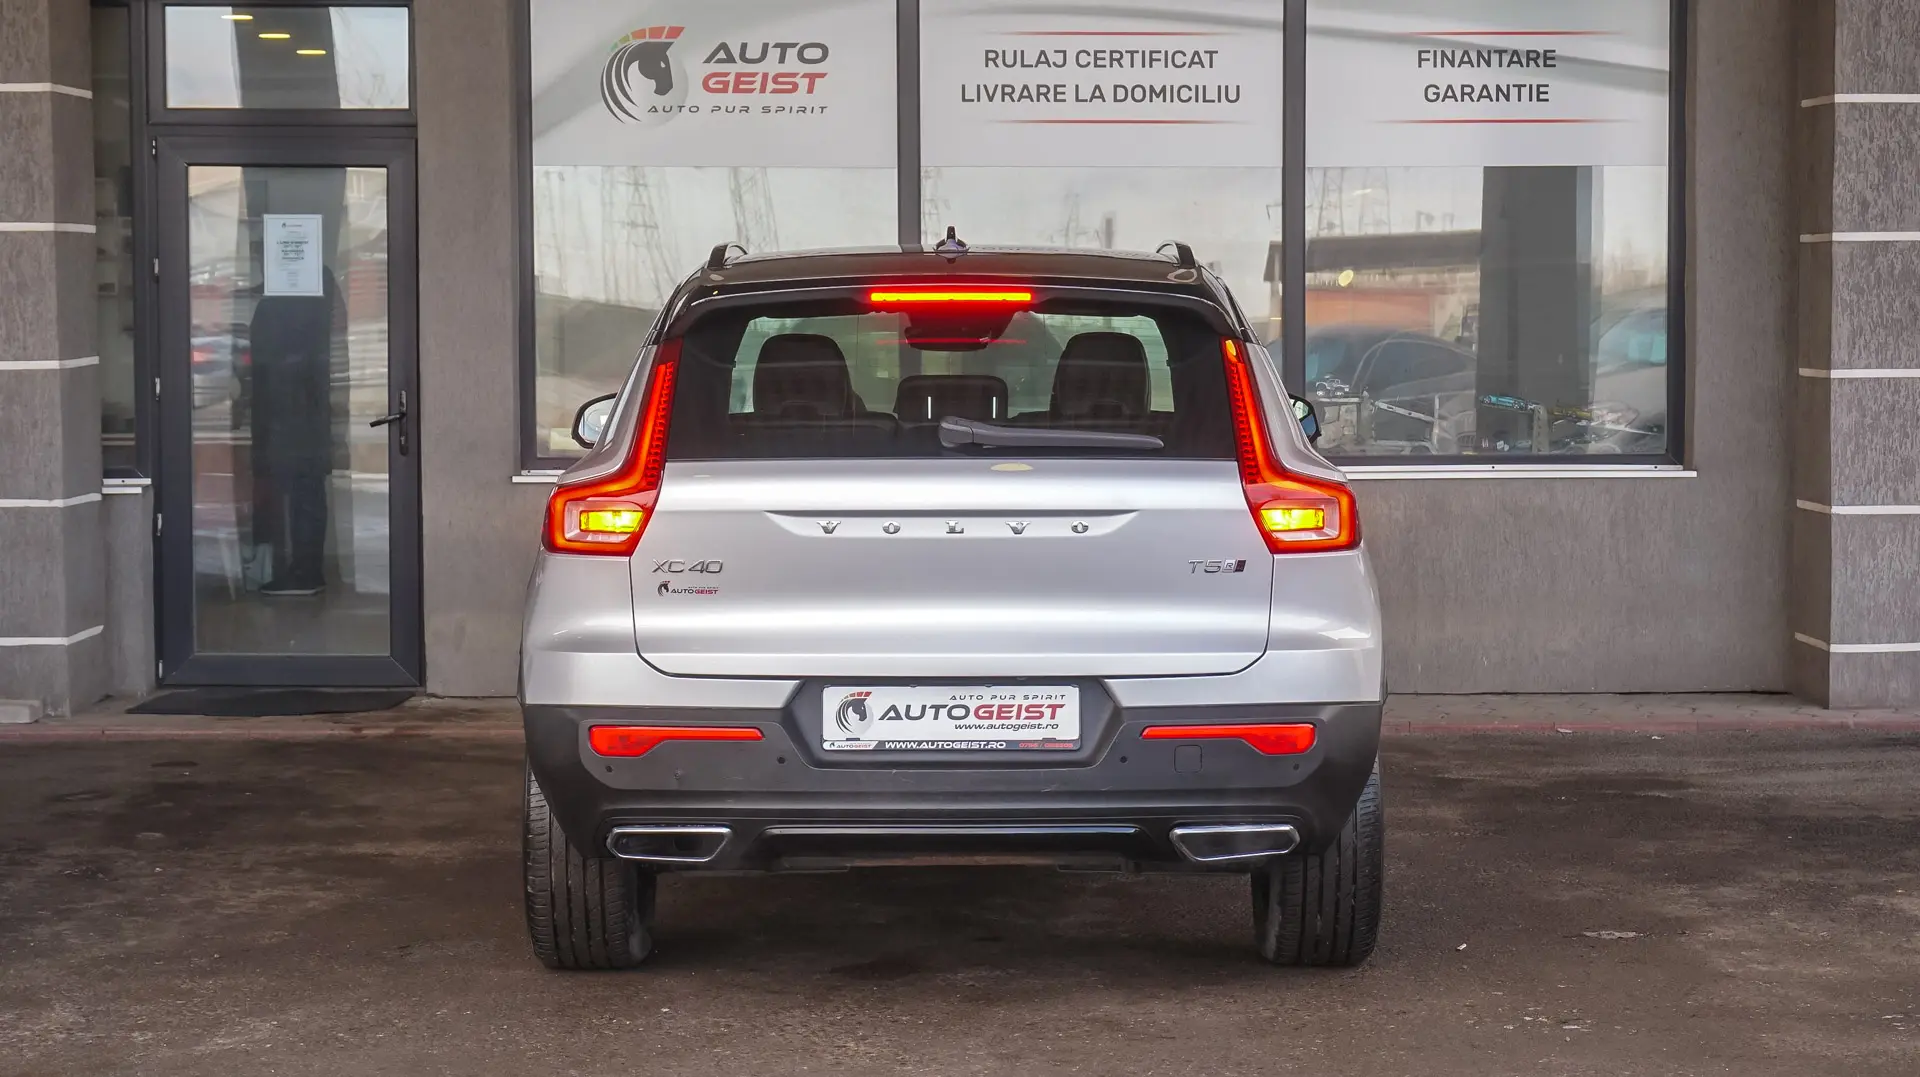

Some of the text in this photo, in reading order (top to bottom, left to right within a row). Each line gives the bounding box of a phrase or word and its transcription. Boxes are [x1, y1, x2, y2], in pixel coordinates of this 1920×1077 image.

[702, 41, 829, 65] AUTO
[984, 49, 1219, 69] RULAJ CERTIFICAT
[1416, 49, 1557, 69] FINANTARE
[702, 72, 828, 94] GEIST
[1423, 83, 1551, 103] GARANTIE
[960, 84, 1242, 104] LIVRARE LA DOMICILIU
[647, 105, 829, 114] AUTO PUR SPIRIT
[816, 520, 1089, 535] VOLVO
[878, 703, 1066, 721] AUTOGEIST
[954, 722, 1059, 731] www.autogeist.ro
[885, 741, 1006, 749] WWW.AUTOGEIST.RO
